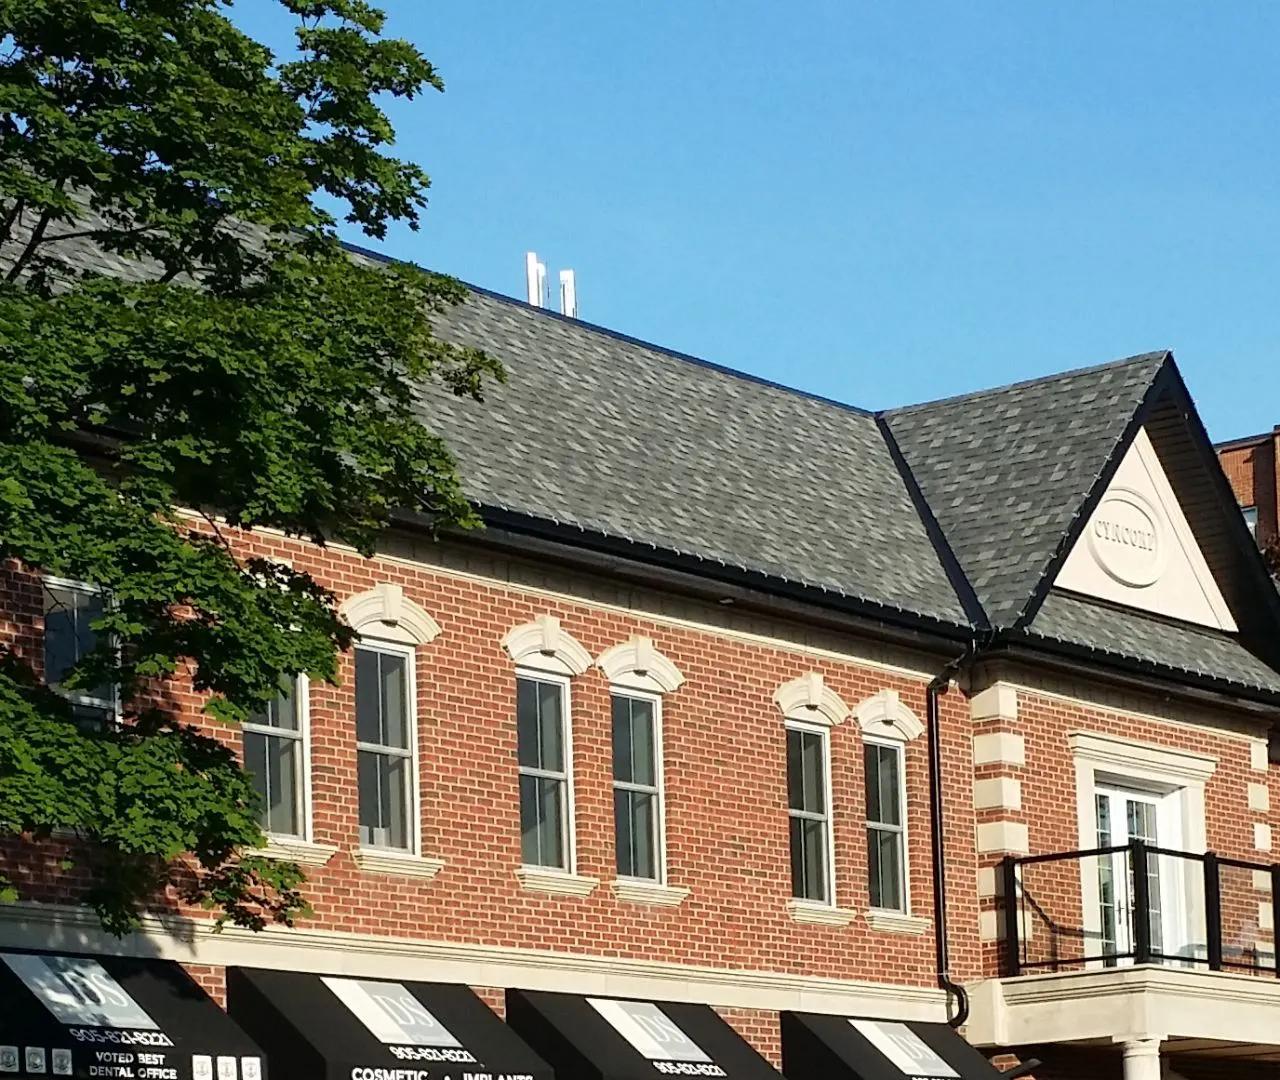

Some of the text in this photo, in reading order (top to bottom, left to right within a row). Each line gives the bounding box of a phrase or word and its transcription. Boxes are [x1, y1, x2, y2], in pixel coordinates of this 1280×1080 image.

[372, 995, 434, 1028] DS
[632, 1014, 686, 1043] DS
[96, 1052, 166, 1065] VOTED BEST
[389, 1046, 477, 1063] 905-821-8221
[89, 1066, 178, 1079] DENTAL OFFICE
